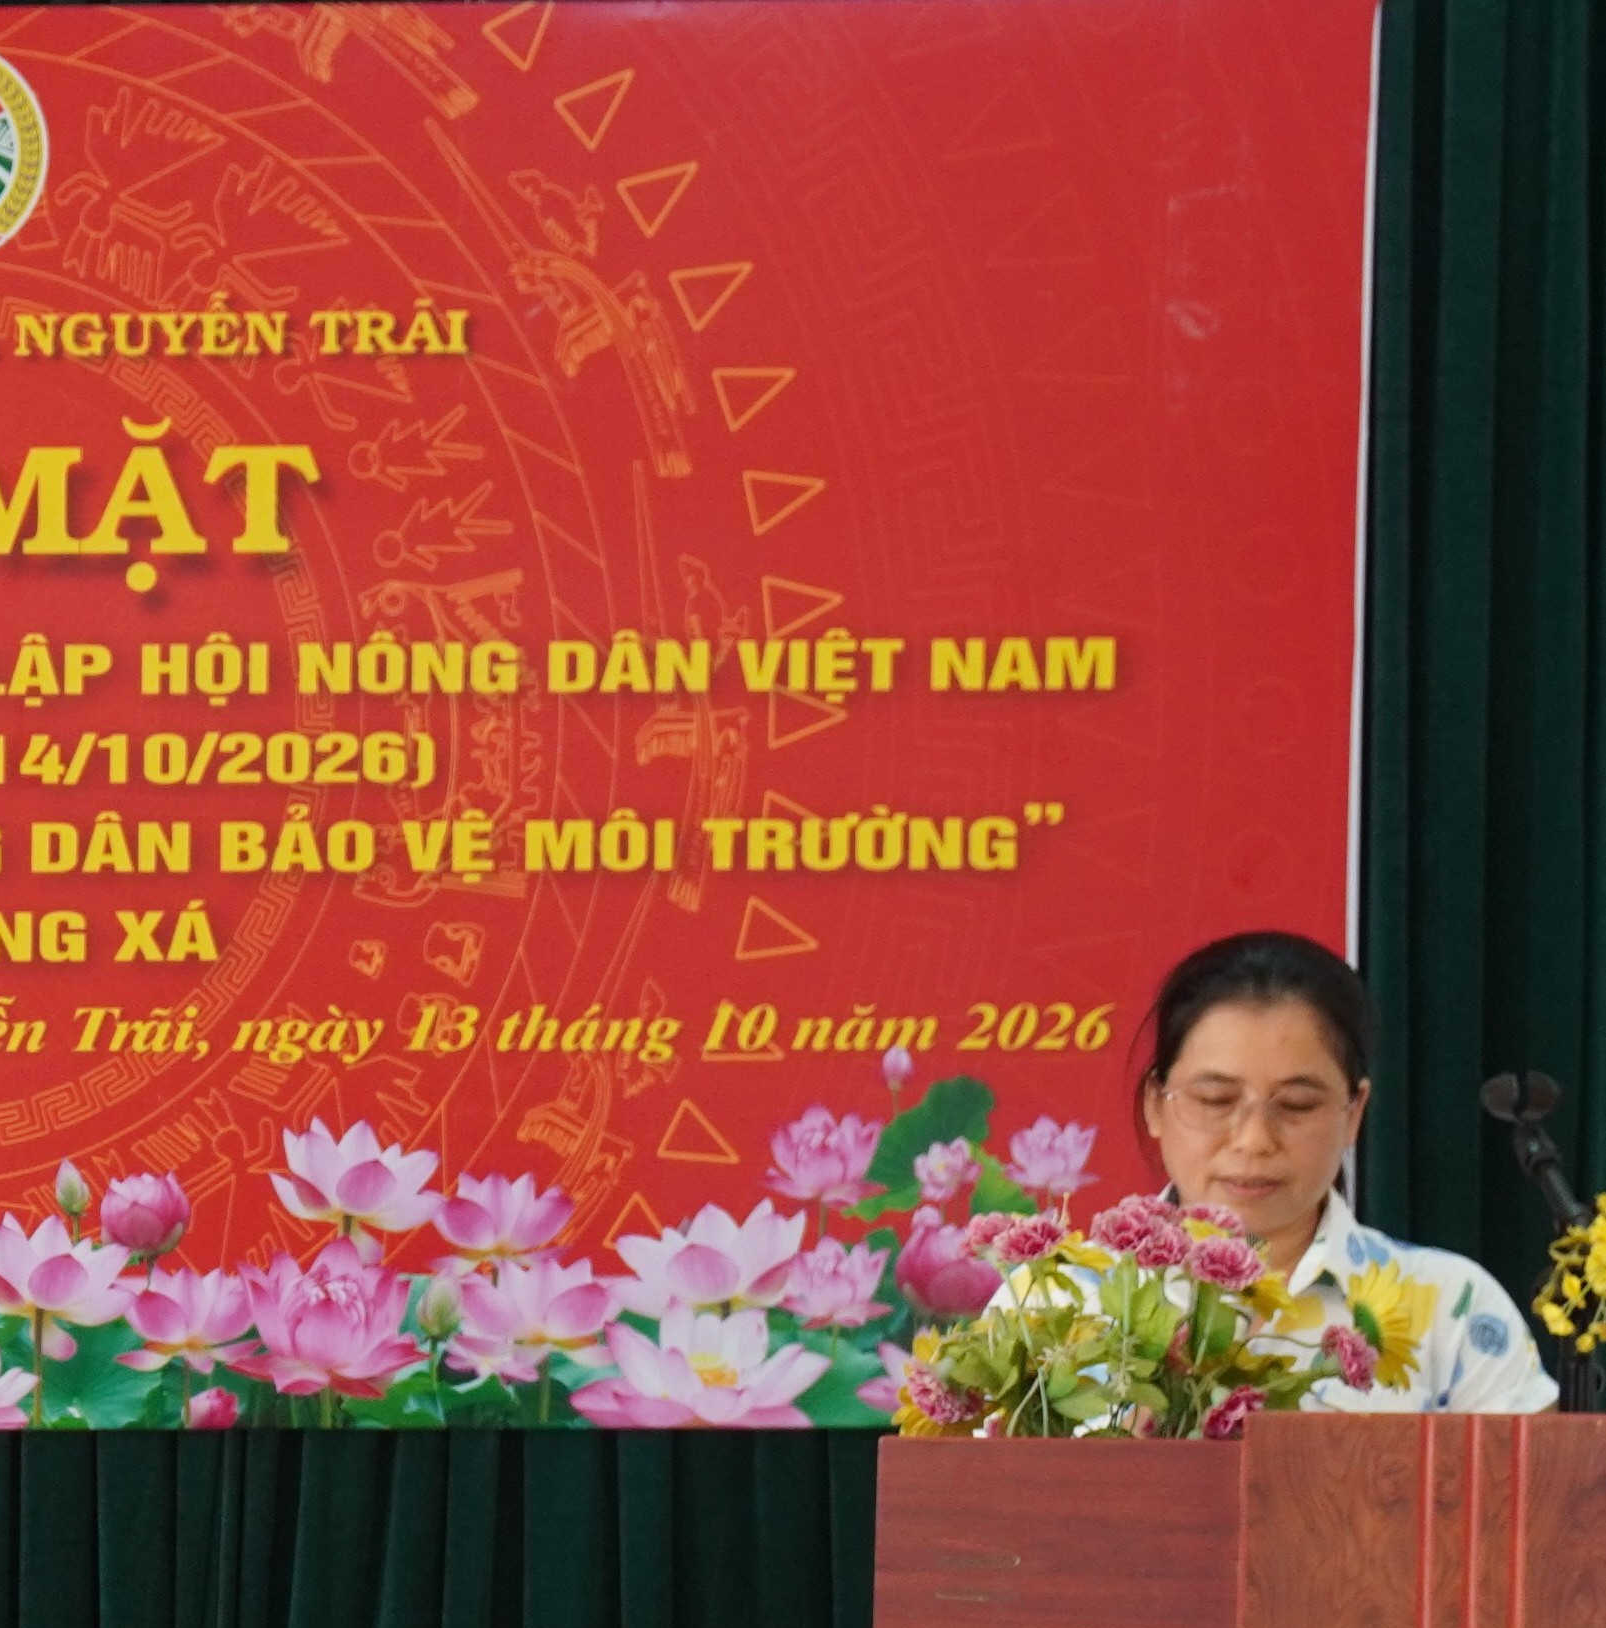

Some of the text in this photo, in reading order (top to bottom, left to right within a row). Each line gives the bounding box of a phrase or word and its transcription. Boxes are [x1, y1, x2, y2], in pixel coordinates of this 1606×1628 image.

[15, 291, 286, 356] NGUYỄN
[310, 299, 467, 353] TRÃI
[141, 632, 268, 706] HỘI
[298, 631, 519, 694] NÔNG
[548, 630, 710, 693] DÂN
[738, 629, 903, 702] VIỆT
[931, 638, 1115, 690] NAM
[31, 811, 190, 873] DÂN
[220, 804, 374, 872] BẢO
[402, 809, 494, 884] VỆ
[525, 809, 674, 871] MÔI
[114, 900, 218, 961] XÁ
[75, 1005, 209, 1057] Trãi,
[232, 1006, 383, 1064] ngày
[410, 1005, 479, 1051] 13
[497, 1004, 680, 1062] tháng
[704, 1003, 776, 1051] 10
[793, 1008, 936, 1050] năm
[960, 1004, 1108, 1049] 2026
